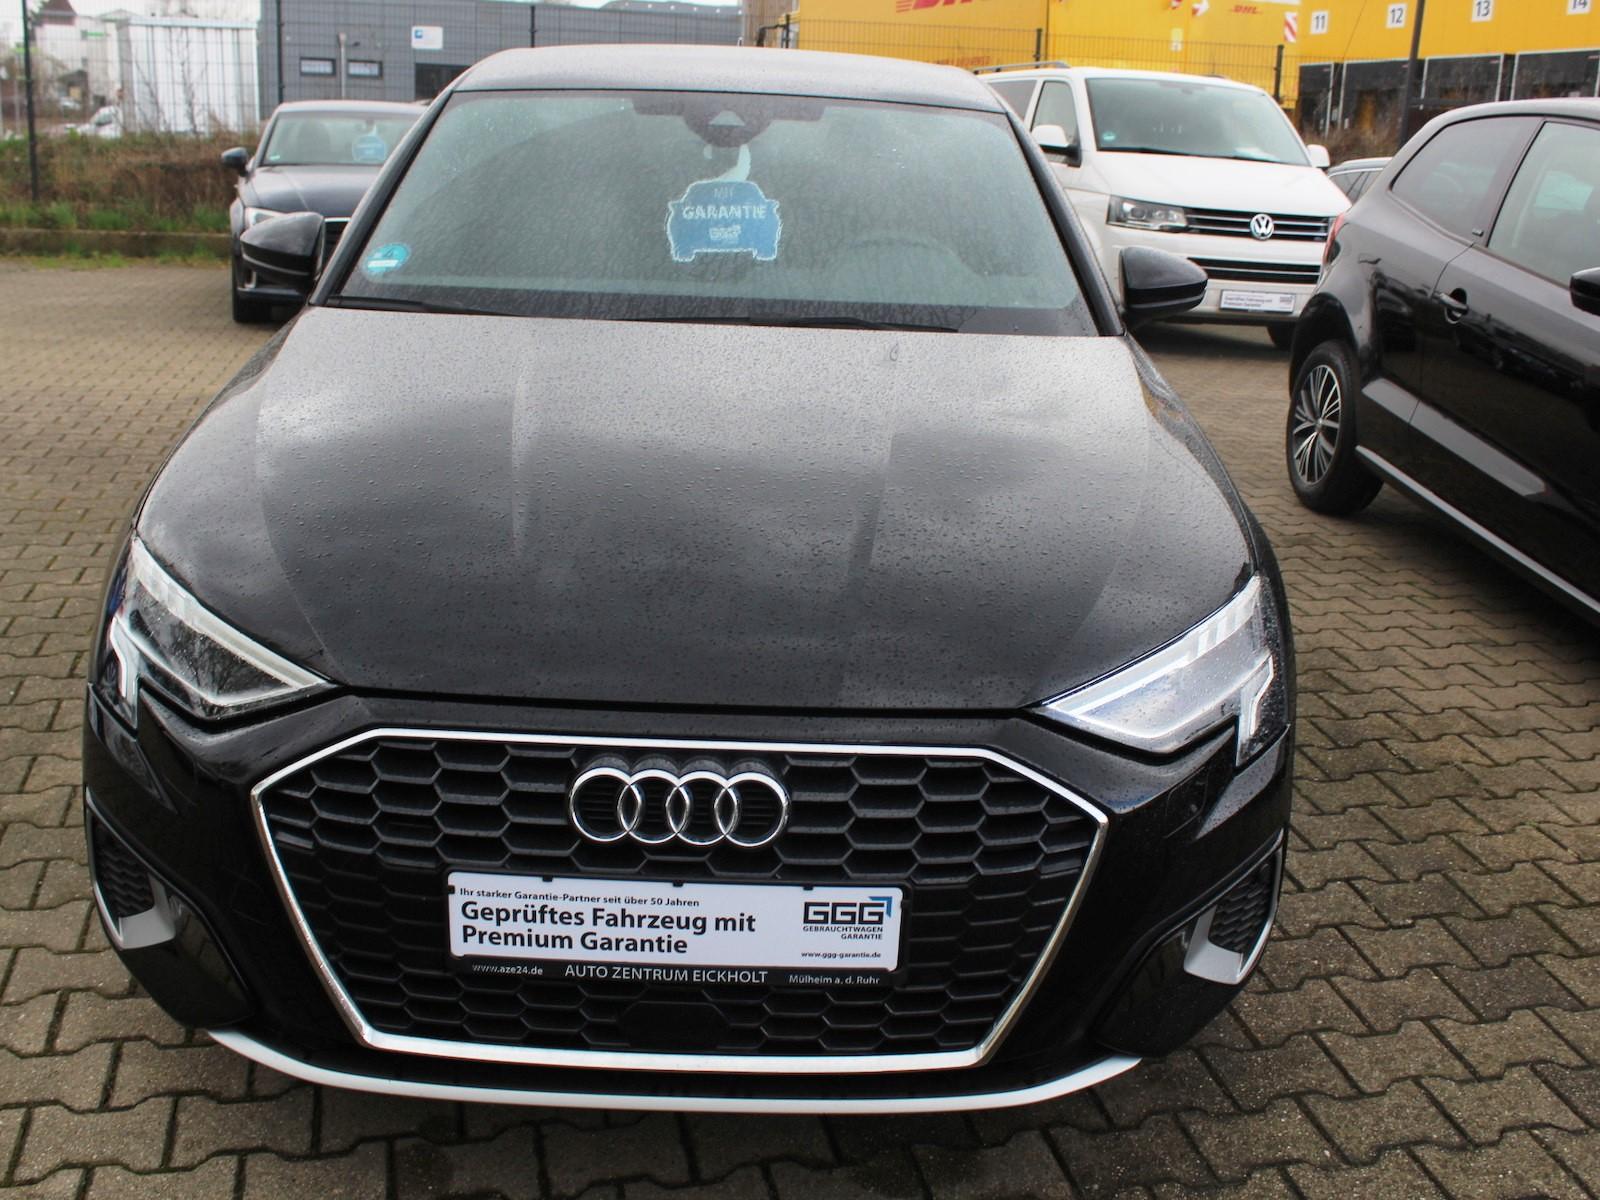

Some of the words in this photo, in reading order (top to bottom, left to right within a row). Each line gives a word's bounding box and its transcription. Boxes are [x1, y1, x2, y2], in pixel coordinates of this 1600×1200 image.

[1390, 7, 1404, 24] 12
[1475, 0, 1491, 17] 13
[1315, 14, 1326, 30] 11
[682, 204, 767, 220] GARANTIE
[459, 887, 474, 896] Ihr
[476, 889, 512, 899] starker
[514, 891, 600, 903] Garantie-Partner
[603, 896, 621, 904] seit
[624, 896, 648, 905] über
[650, 897, 663, 906] 50
[665, 898, 700, 907] Jahren
[461, 901, 585, 927] Geprüftes
[592, 907, 707, 936] Fahrzeug
[714, 912, 756, 932] mit
[803, 902, 885, 925] GGG
[802, 925, 883, 933] GEBRAUCHTWAGEN
[462, 925, 573, 950] Premium
[580, 931, 688, 954] Garantie
[472, 964, 543, 975] www.aze24.de
[565, 964, 608, 978] AUTO
[612, 966, 688, 982] ZENTRUM
[692, 970, 768, 983] EICKHOLT
[788, 975, 833, 984] Mülheim
[856, 976, 881, 985] Ruhr
